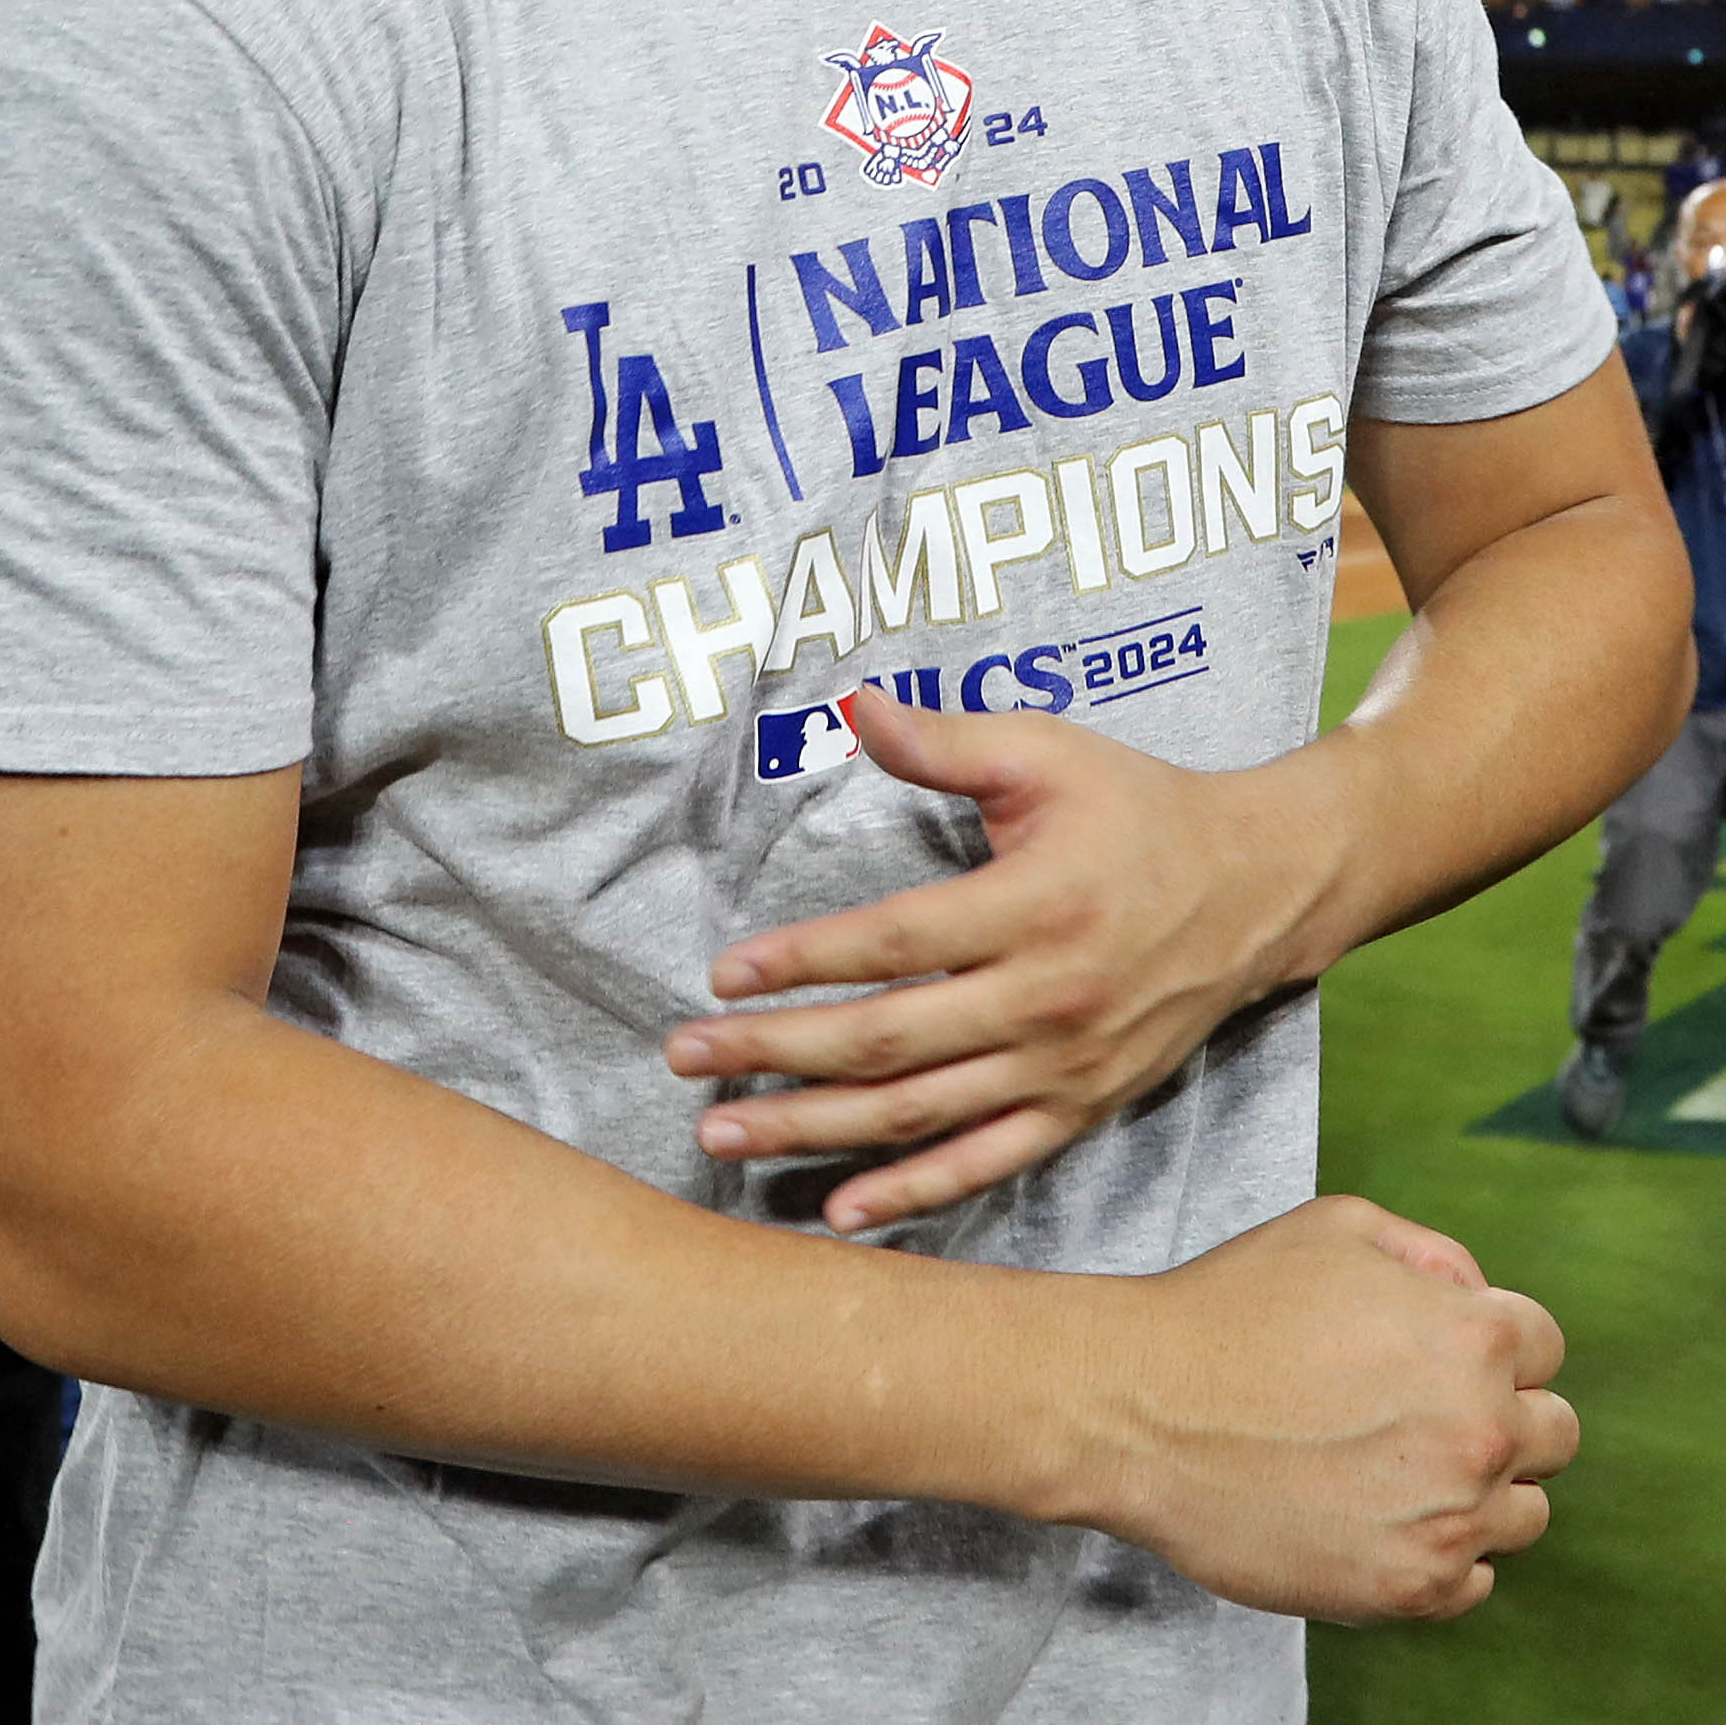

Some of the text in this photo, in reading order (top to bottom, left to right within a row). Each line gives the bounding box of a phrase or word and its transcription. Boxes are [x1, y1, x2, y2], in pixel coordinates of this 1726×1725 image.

[778, 106, 1048, 201] 20 24
[875, 90, 929, 120] N.L.
[789, 142, 1311, 353] NATIONAL
[561, 302, 725, 553] LA
[826, 281, 1246, 478] LEAGUE
[542, 392, 1346, 748] CHAMPIONS
[1082, 623, 1207, 689] 2024
